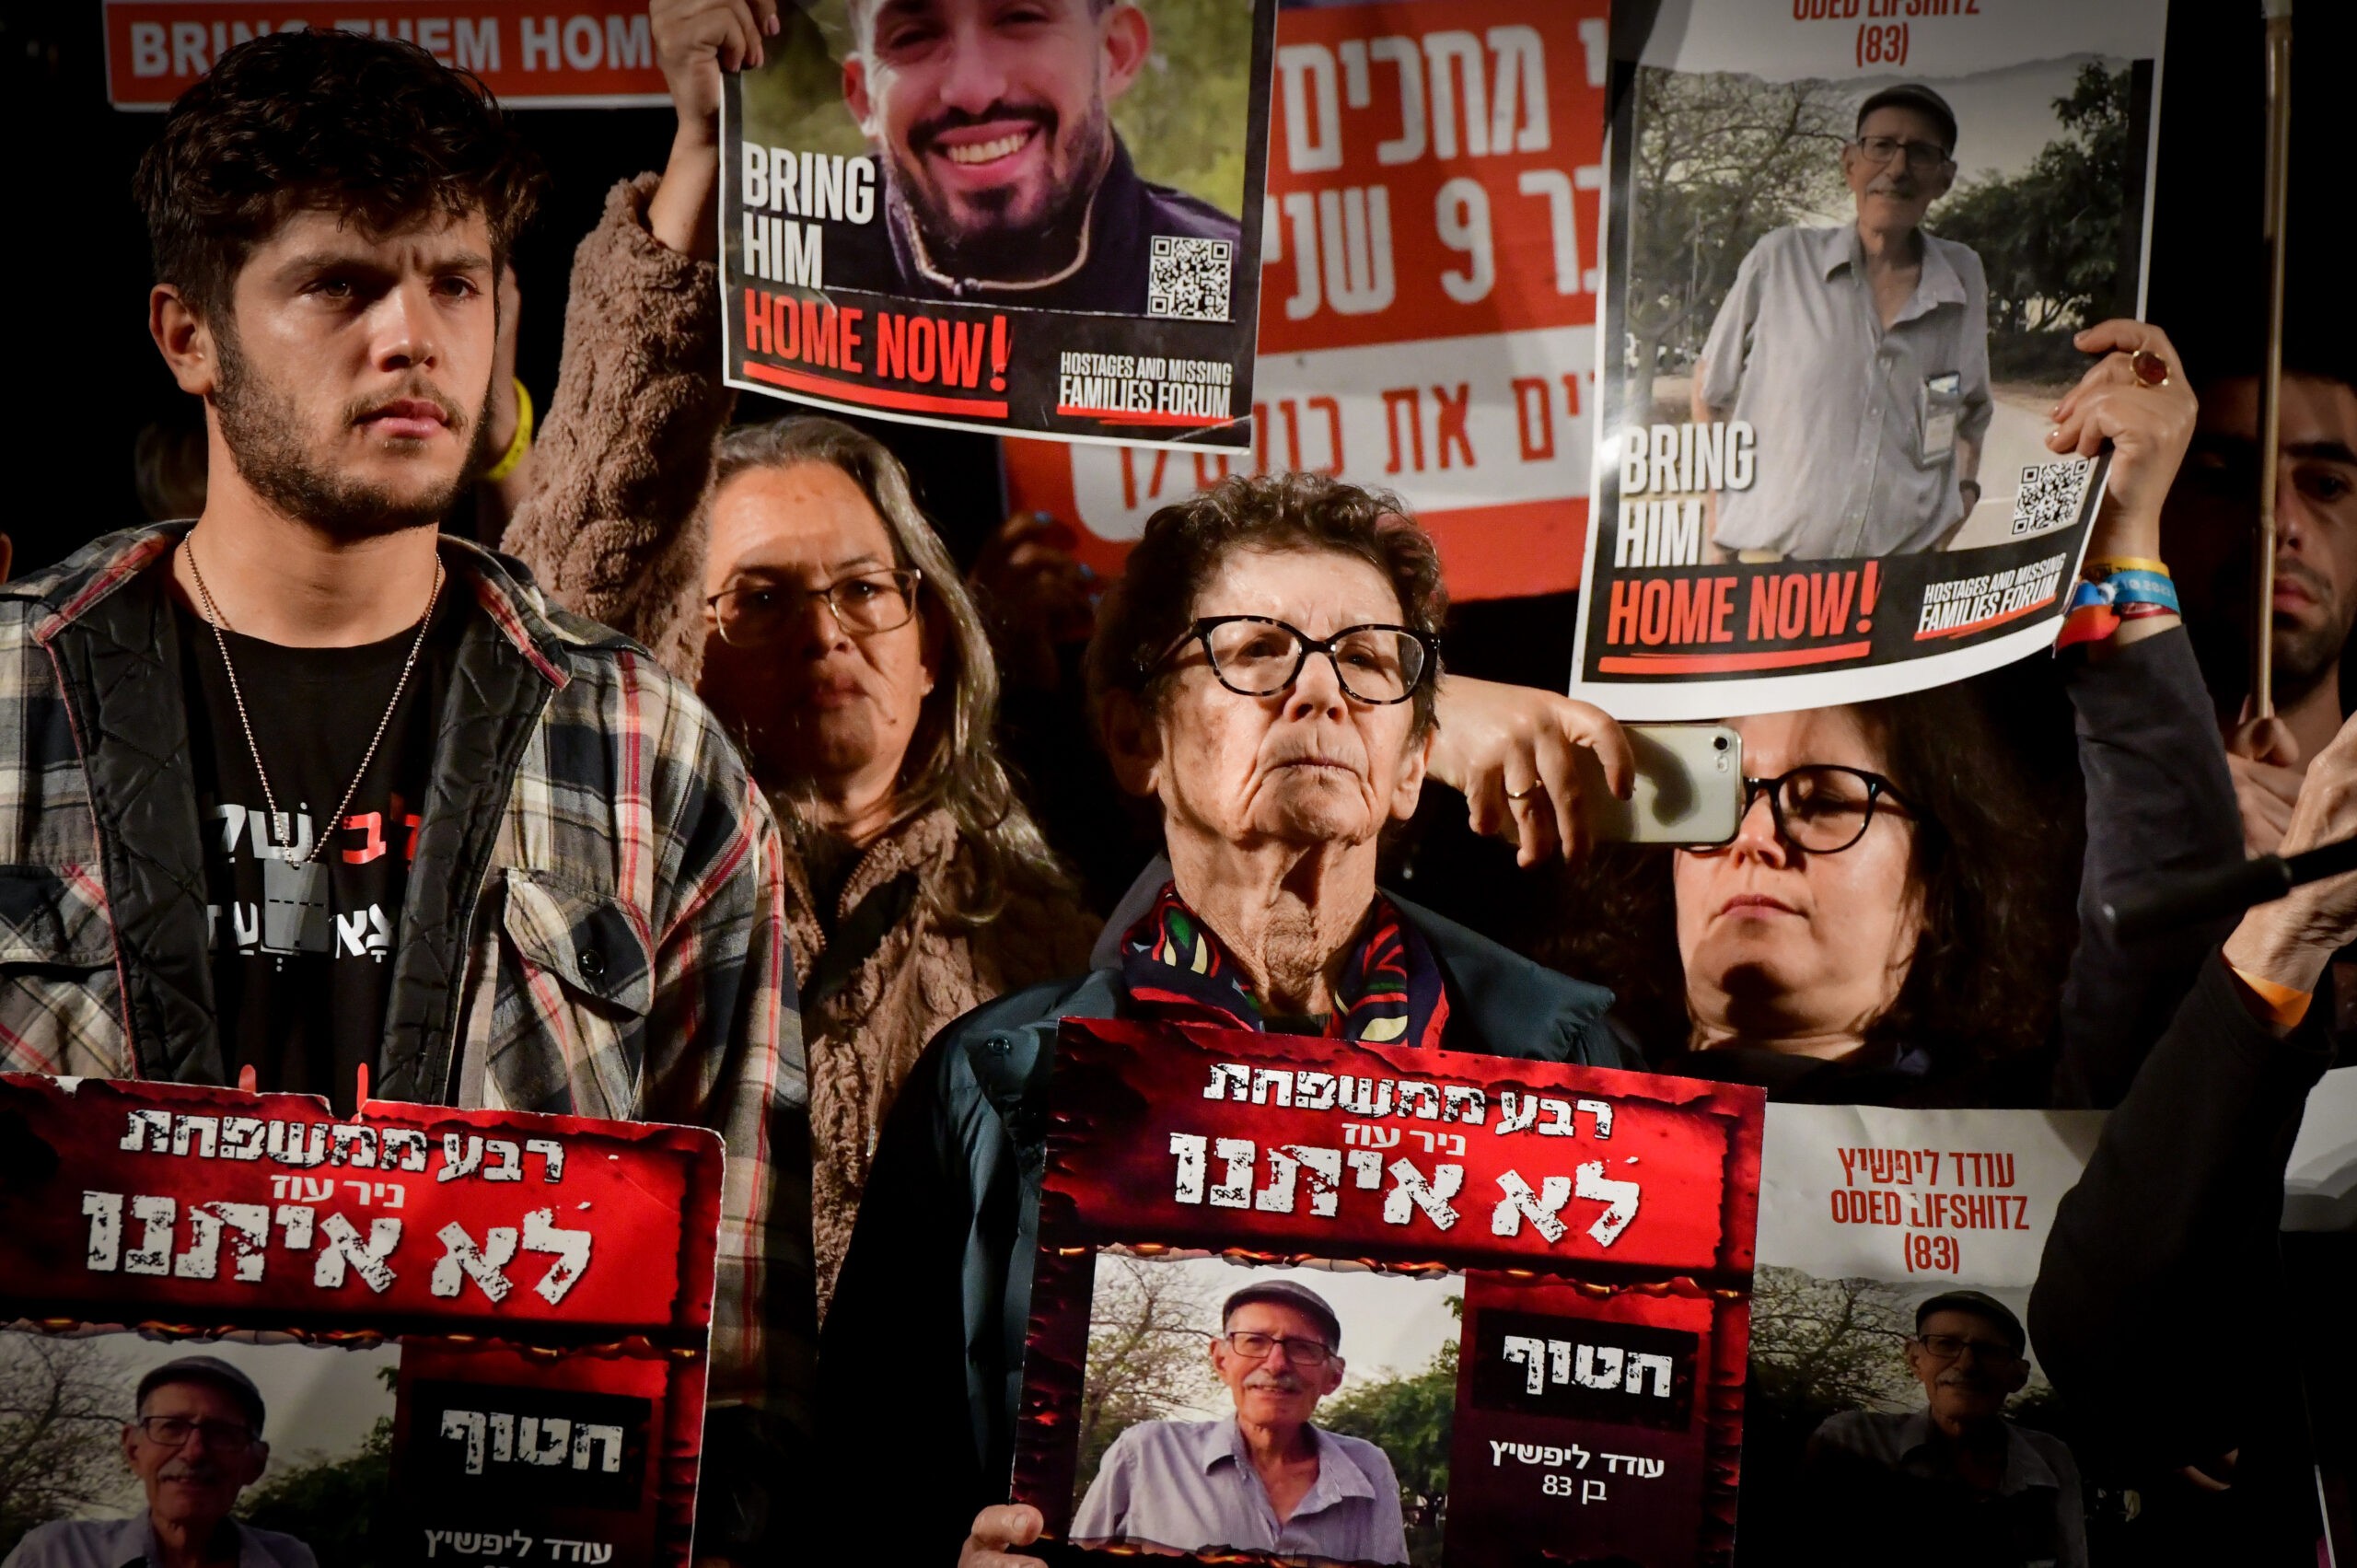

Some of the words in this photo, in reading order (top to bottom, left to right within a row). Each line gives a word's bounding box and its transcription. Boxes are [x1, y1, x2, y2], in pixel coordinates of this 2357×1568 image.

[129, 18, 310, 79] BRI
[518, 13, 653, 73] HOM
[1855, 22, 1910, 67] (83)
[1277, 24, 1551, 174] מחכים
[741, 141, 877, 226] BRING
[743, 213, 824, 290] HIM
[1260, 184, 1398, 321] שני
[1434, 178, 1496, 303] 9
[744, 288, 863, 373] HOME
[877, 311, 1009, 393] NOW!
[1061, 351, 1134, 378] HOSTAGES
[1135, 356, 1167, 381] AND
[1168, 358, 1233, 386] MISSING
[1060, 375, 1153, 414] FAMILIES
[1156, 381, 1232, 419] FORUM
[1384, 383, 1476, 473] את
[1618, 420, 1756, 494] BRING
[1614, 499, 1703, 569] HIM
[1606, 576, 1738, 645] HOME
[1747, 560, 1882, 641] NOW!
[1917, 592, 2002, 634] FAMILIES
[1998, 571, 2061, 616] FORUM
[1923, 575, 1991, 605] HOSTAGES
[1989, 569, 2016, 592] AND
[2014, 552, 2067, 586] MISSING
[1202, 1063, 1487, 1126] ממשפחת
[1494, 1090, 1614, 1141] רבע
[119, 1109, 428, 1172] ממשפחת
[436, 1132, 565, 1184] רבע
[1341, 1122, 1401, 1150] עוז
[1410, 1129, 1467, 1157] ניר
[269, 1174, 334, 1203] עוז
[342, 1178, 405, 1209] ניר
[1168, 1132, 1466, 1232] איתנו
[1837, 1148, 1940, 1187] ליפשיץ
[1948, 1152, 2015, 1188] עודד
[1491, 1159, 1642, 1249] לא
[1830, 1189, 1902, 1225] ODED
[1910, 1192, 2030, 1230] LIFSHITZ
[82, 1190, 403, 1294] איתנו
[430, 1202, 592, 1305] לא
[1904, 1232, 1960, 1274] (83)
[1503, 1335, 1674, 1399] חטוף
[440, 1409, 625, 1476] חטוף
[1489, 1440, 1591, 1469] ליפשיץ
[1599, 1452, 1666, 1479] עודד
[1542, 1474, 1573, 1497] 83
[1581, 1479, 1608, 1505] בן
[424, 1527, 534, 1560] ליפשיץ
[542, 1537, 614, 1565] עודד
